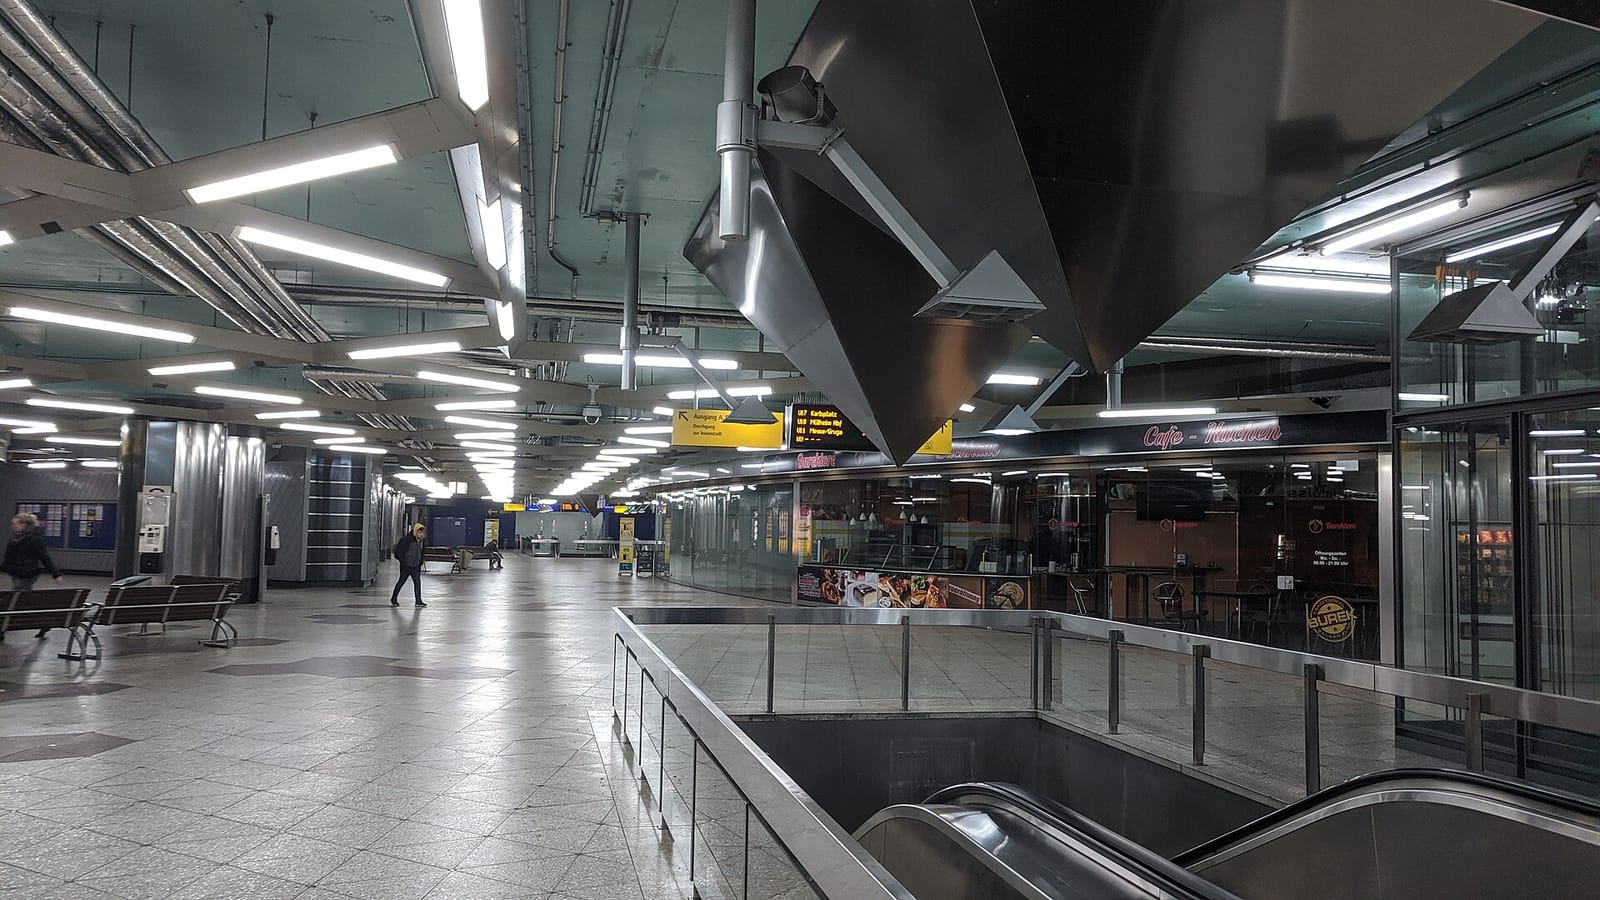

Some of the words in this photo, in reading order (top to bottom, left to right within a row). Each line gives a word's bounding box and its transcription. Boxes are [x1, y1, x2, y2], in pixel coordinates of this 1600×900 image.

[693, 413, 717, 422] Ausgang
[1204, 421, 1283, 444] Kuchen
[1308, 608, 1358, 629] BUREK
